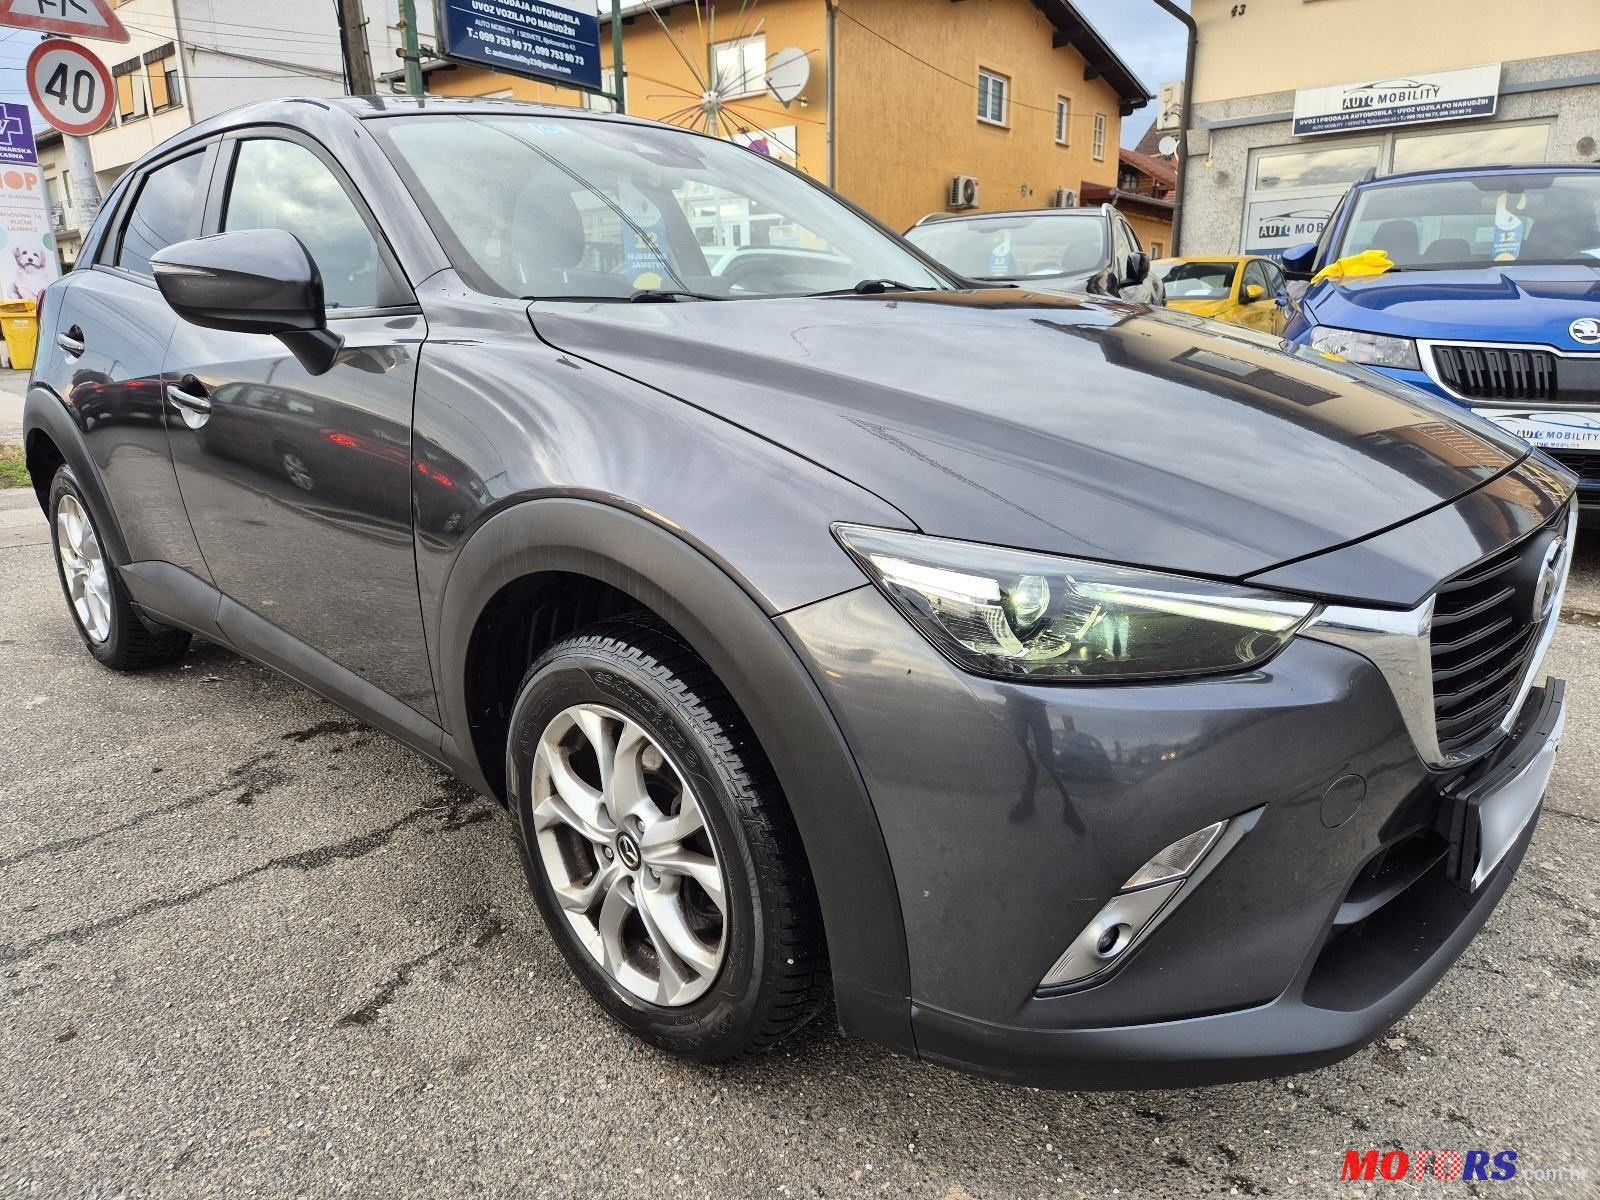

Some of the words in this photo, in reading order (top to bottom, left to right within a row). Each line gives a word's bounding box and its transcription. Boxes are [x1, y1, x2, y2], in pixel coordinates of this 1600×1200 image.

[472, 1, 495, 14] UVOZ
[496, 7, 525, 23] VOZILA
[526, 16, 538, 26] PO
[538, 18, 576, 36] NARUDŽBI
[494, 0, 530, 11] ODAJA
[531, 4, 580, 26] AUTOMOBILA
[1231, 4, 1246, 17] 43
[475, 19, 490, 28] AUTO
[479, 31, 495, 43] 099
[496, 35, 511, 46] 753
[511, 39, 522, 50] 90
[535, 46, 550, 57] 099
[550, 49, 564, 60] 753
[565, 53, 574, 63] 90
[575, 55, 585, 66] 73
[45, 62, 96, 115] 40
[1342, 95, 1374, 110] AUTO
[1377, 87, 1440, 105] MOBILITY
[1299, 118, 1316, 126] UVOZ
[1320, 115, 1349, 123] PRODAJA
[1350, 110, 1392, 119] AUTOMOBILA
[1397, 106, 1416, 114] UVOZ
[1416, 103, 1441, 112] VOZILA
[1441, 101, 1452, 109] PO
[1259, 224, 1290, 238] AUTO
[1546, 431, 1600, 441] MOBILITY
